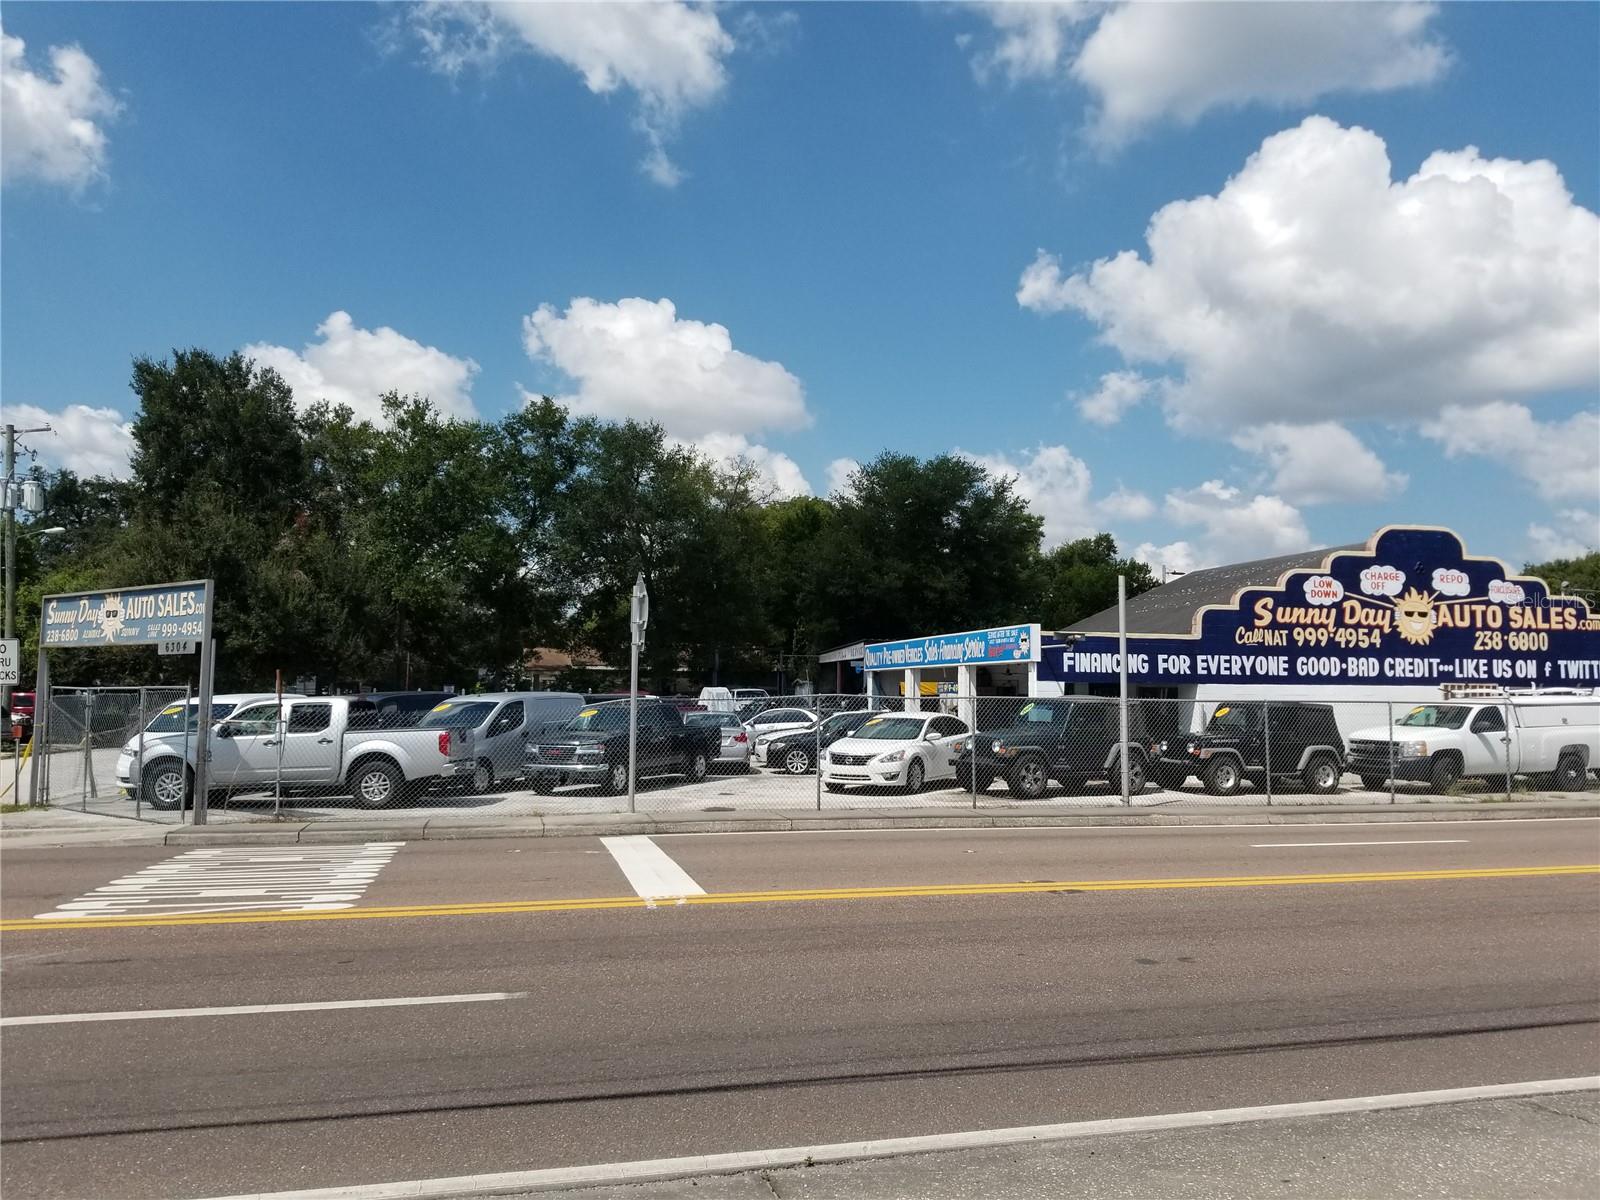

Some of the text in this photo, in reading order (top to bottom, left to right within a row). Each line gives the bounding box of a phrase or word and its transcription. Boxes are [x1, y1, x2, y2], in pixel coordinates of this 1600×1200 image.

[1364, 572, 1400, 581] CHARGE
[1440, 574, 1463, 584] REPO
[1313, 580, 1333, 589] LOW
[1370, 581, 1386, 590] OFF
[1310, 589, 1338, 599] DOWN
[125, 595, 155, 620] AUTO
[47, 599, 99, 628] Sunny Day
[1253, 597, 1392, 634] Sunny Day
[1437, 604, 1503, 628] AUTO
[46, 629, 79, 643] 238-6800
[1235, 626, 1264, 646] Call
[1264, 630, 1289, 646] NAT
[0, 643, 7, 654] O
[0, 657, 11, 667] RU
[1063, 652, 1149, 675] FINANCNG
[1157, 654, 1191, 675] FOR
[1196, 655, 1289, 676] EVERYONE
[1492, 659, 1512, 678] US
[1515, 659, 1537, 678] ON
[1557, 660, 1600, 679] TWITT
[0, 670, 17, 680] CKS
